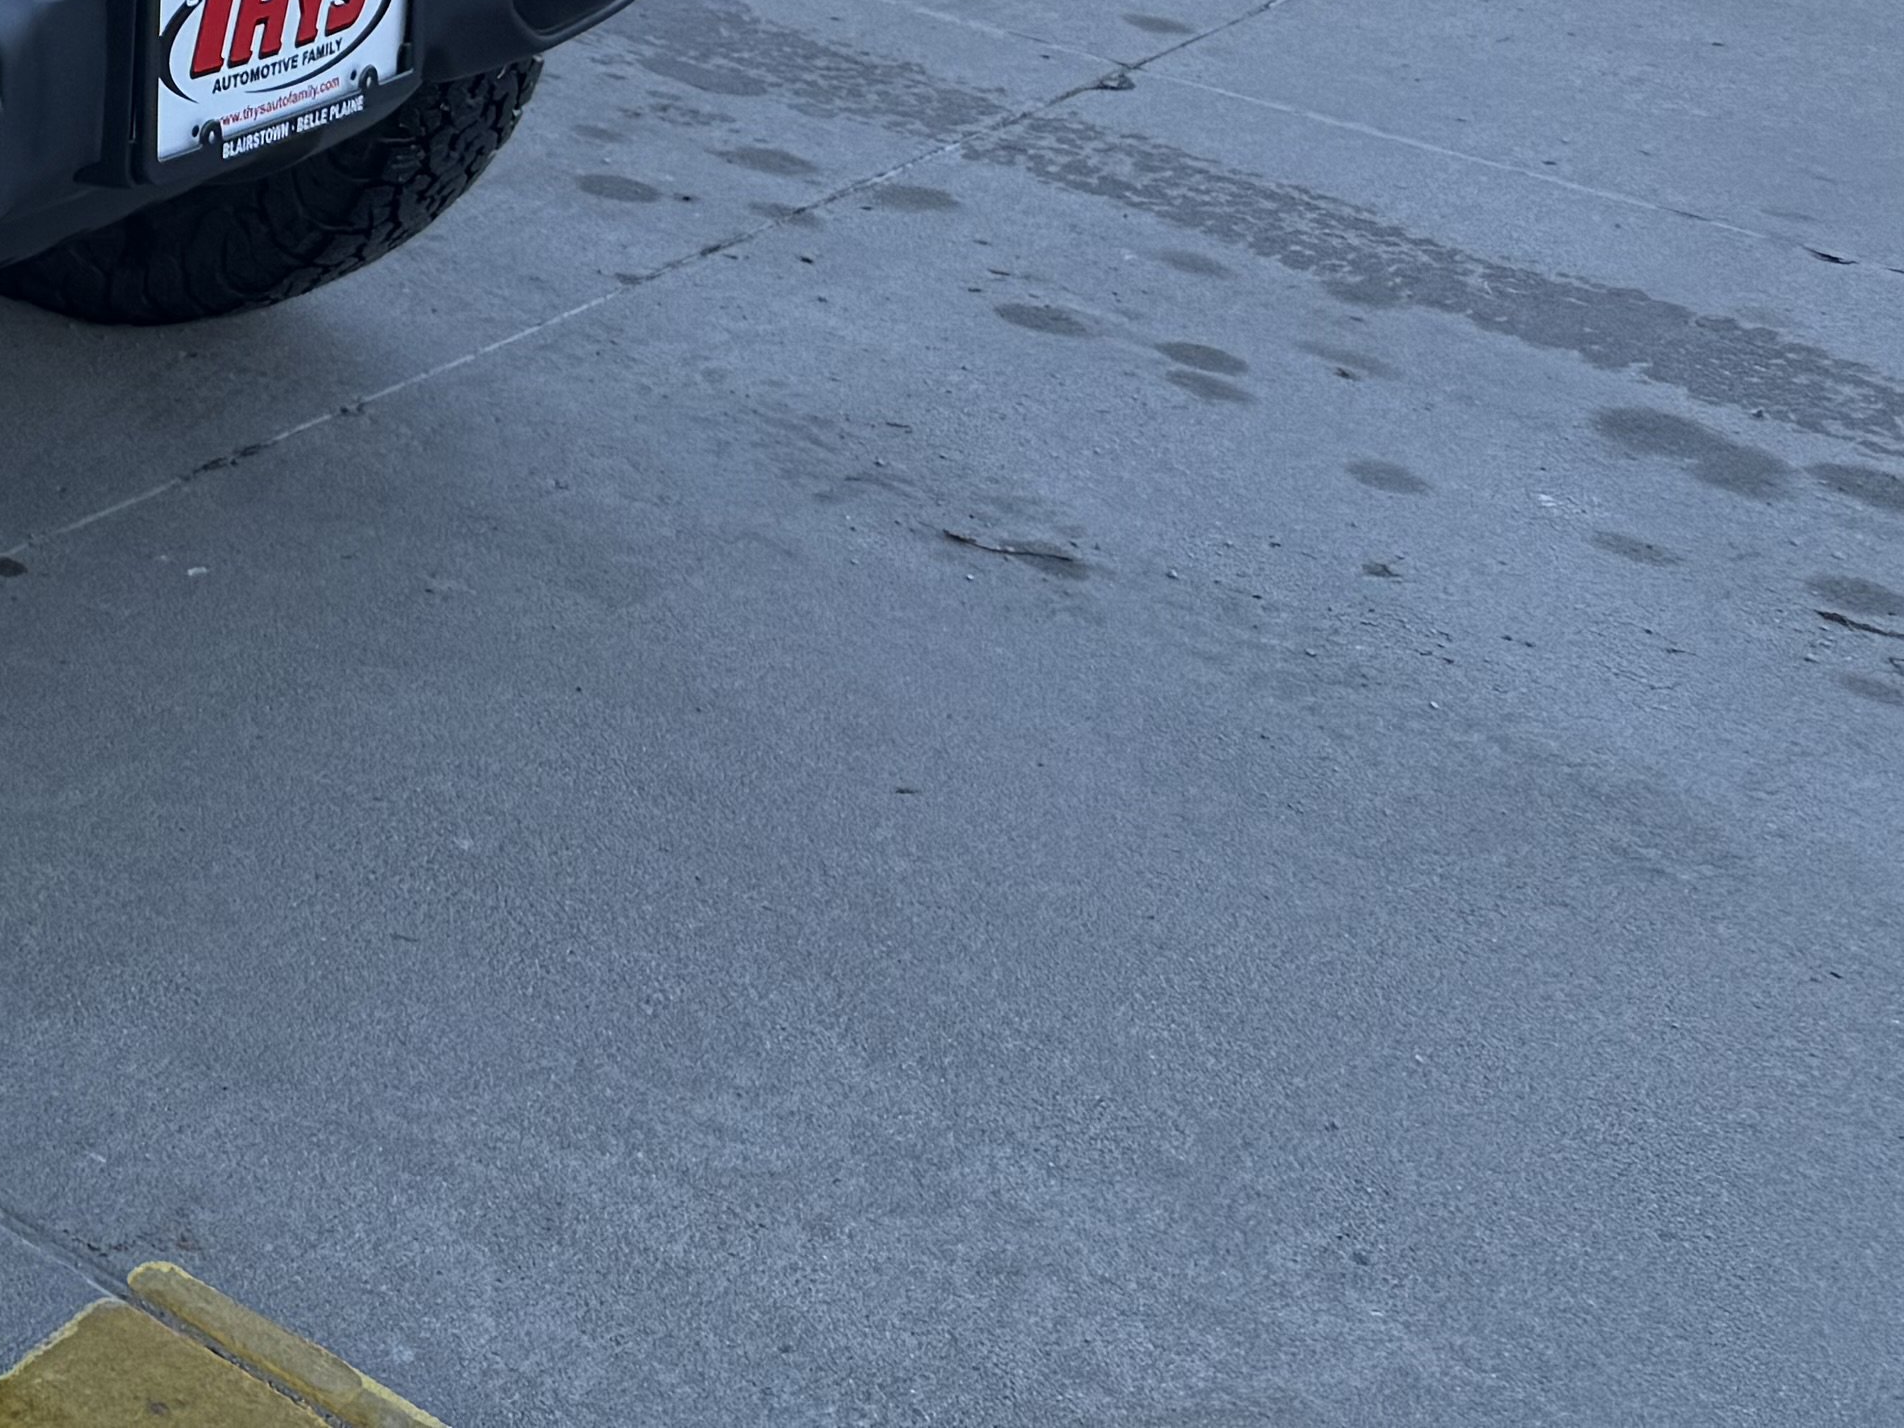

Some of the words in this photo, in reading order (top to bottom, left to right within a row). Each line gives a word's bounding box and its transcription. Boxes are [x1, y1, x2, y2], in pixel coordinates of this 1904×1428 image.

[212, 54, 299, 94] AUTOMOTIVE
[302, 37, 343, 66] FAMILY
[219, 76, 340, 125] ww.thysautofamily.com
[222, 121, 290, 160] BLAIRSTOWN
[296, 108, 329, 134] BELLE
[329, 95, 365, 122] PLAINE
